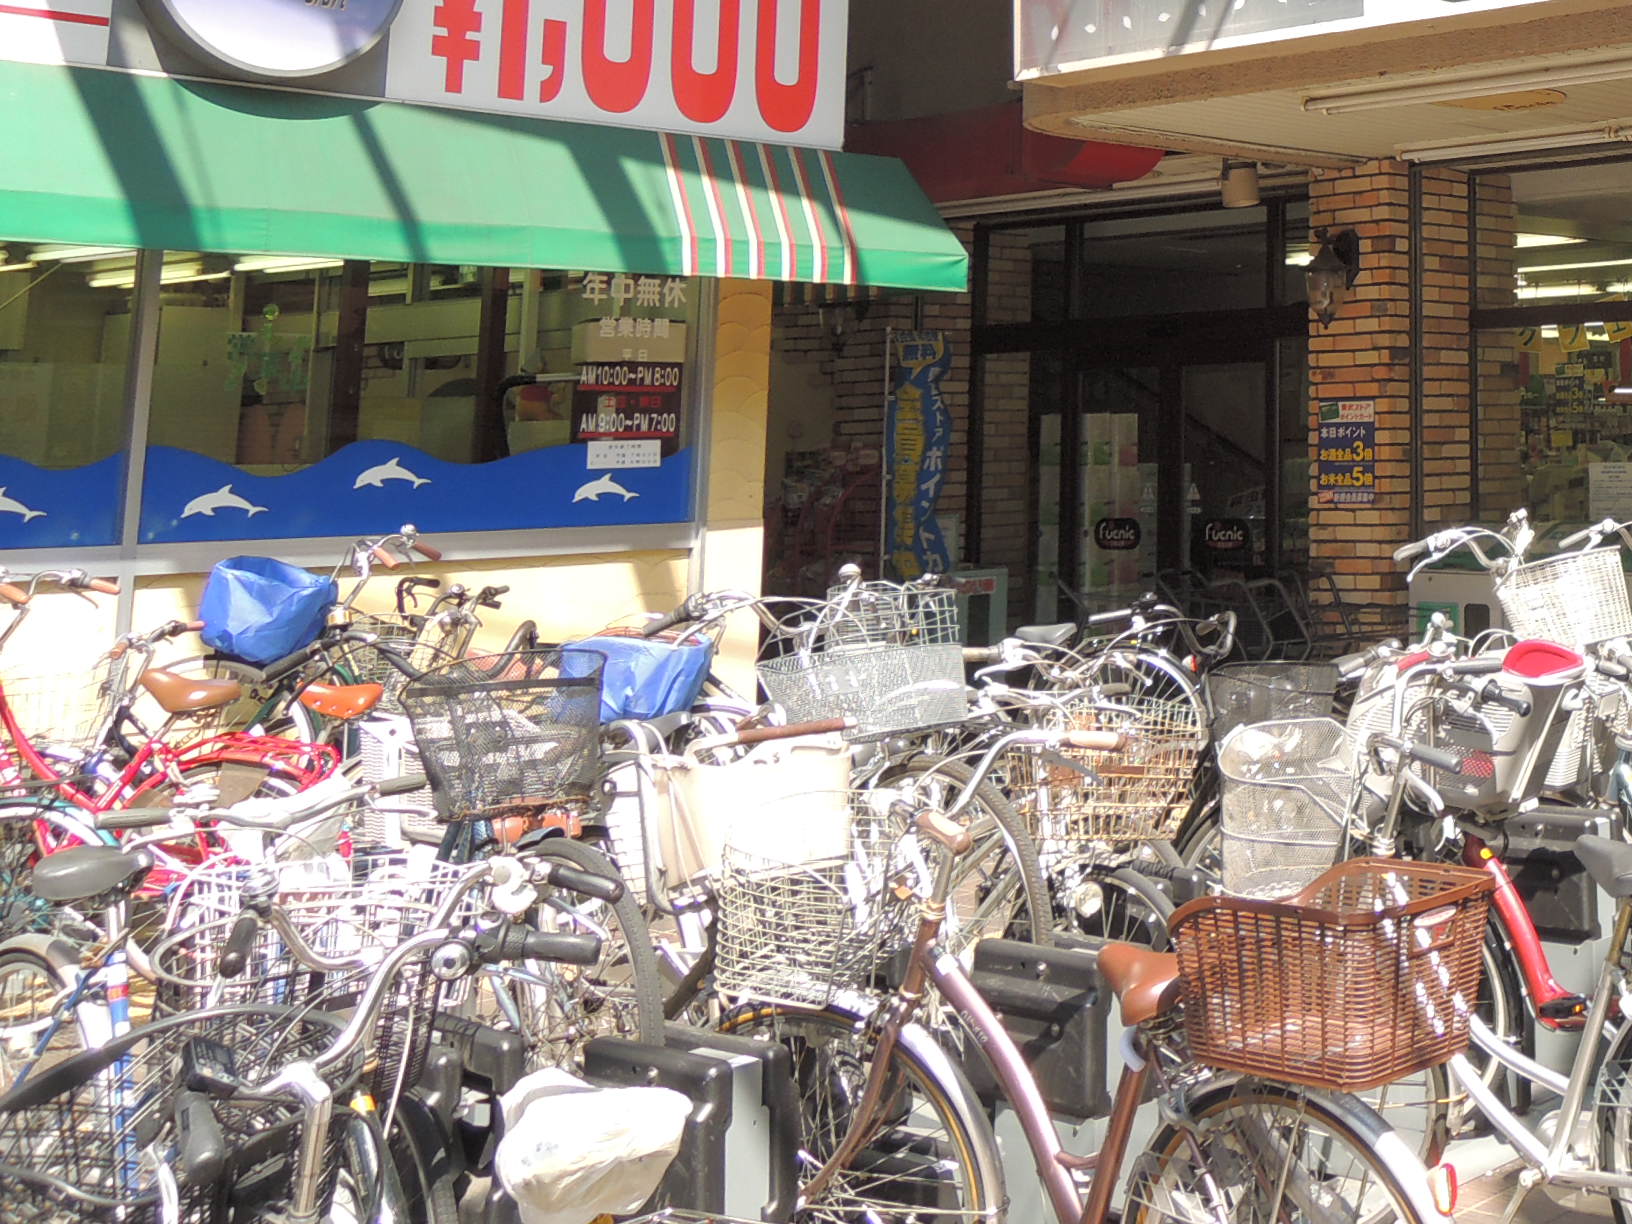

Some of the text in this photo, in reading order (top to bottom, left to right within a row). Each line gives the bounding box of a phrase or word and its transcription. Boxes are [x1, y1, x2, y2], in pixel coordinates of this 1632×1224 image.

[581, 271, 688, 308] 年中無休
[599, 317, 670, 339] 営業時間
[1320, 426, 1366, 439] 本日ポイント
